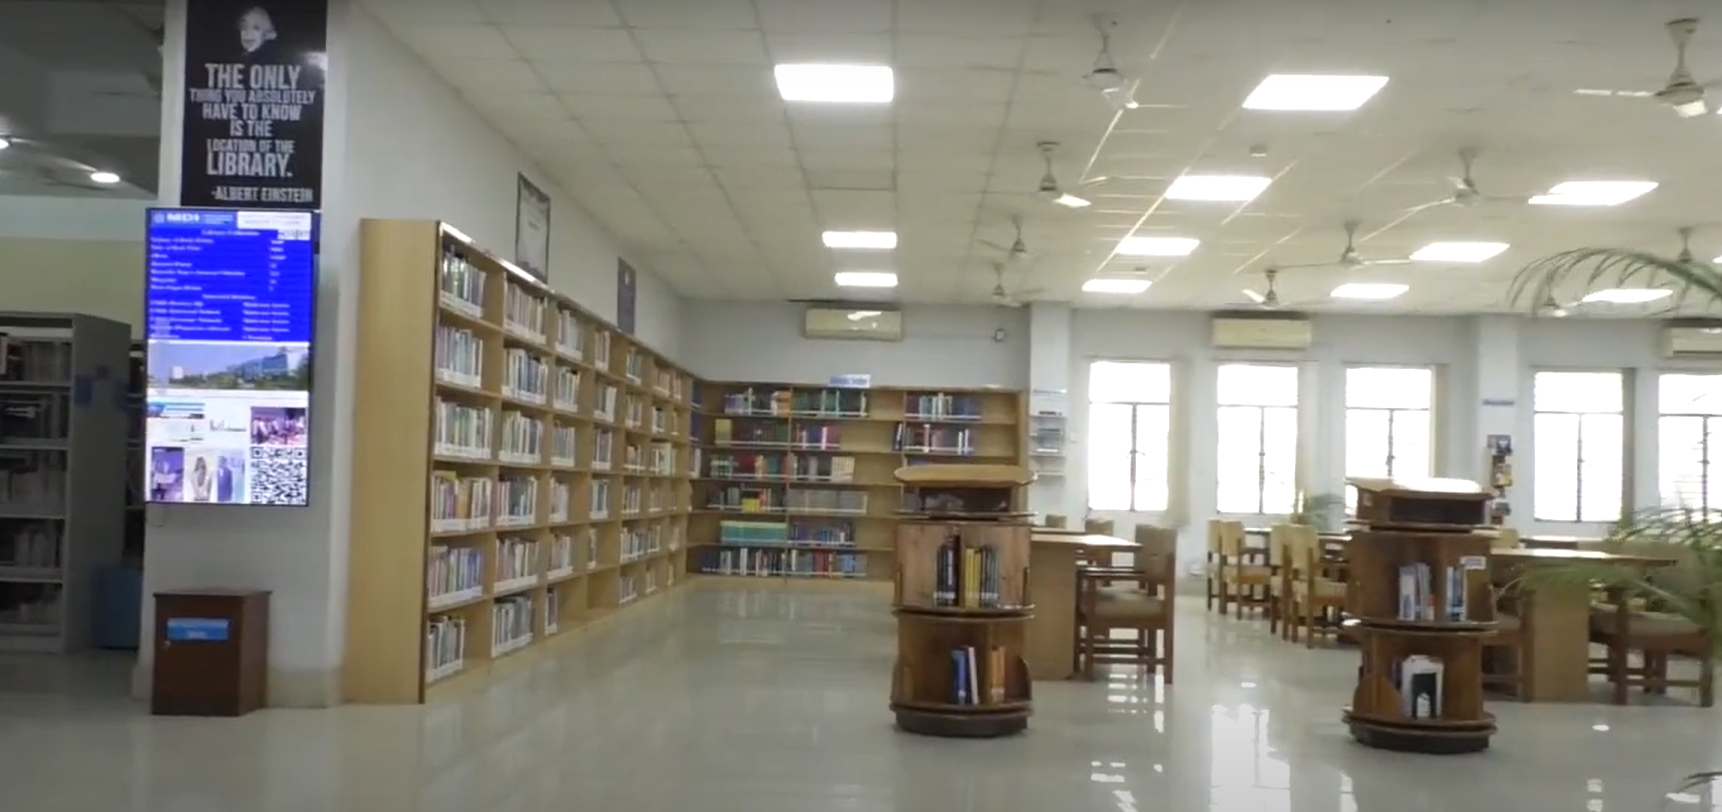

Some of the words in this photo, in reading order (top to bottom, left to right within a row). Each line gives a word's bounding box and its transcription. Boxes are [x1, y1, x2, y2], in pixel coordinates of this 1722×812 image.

[205, 63, 245, 88] THE
[249, 64, 301, 90] ONLY
[189, 87, 222, 103] THING
[224, 89, 246, 103] YOU
[248, 89, 316, 105] ABSOLUTELY
[202, 103, 238, 119] HAVE
[241, 103, 259, 120] TO
[261, 104, 303, 121] KNOW
[230, 120, 244, 136] IS
[247, 120, 273, 137] THE
[206, 138, 257, 153] LOCATION
[259, 139, 273, 153] OF
[275, 140, 296, 153] THE
[206, 151, 293, 178] LIBRARY.
[211, 186, 259, 201] -ALBERT
[261, 187, 314, 203] EINSTEIN
[166, 212, 200, 223] MDI
